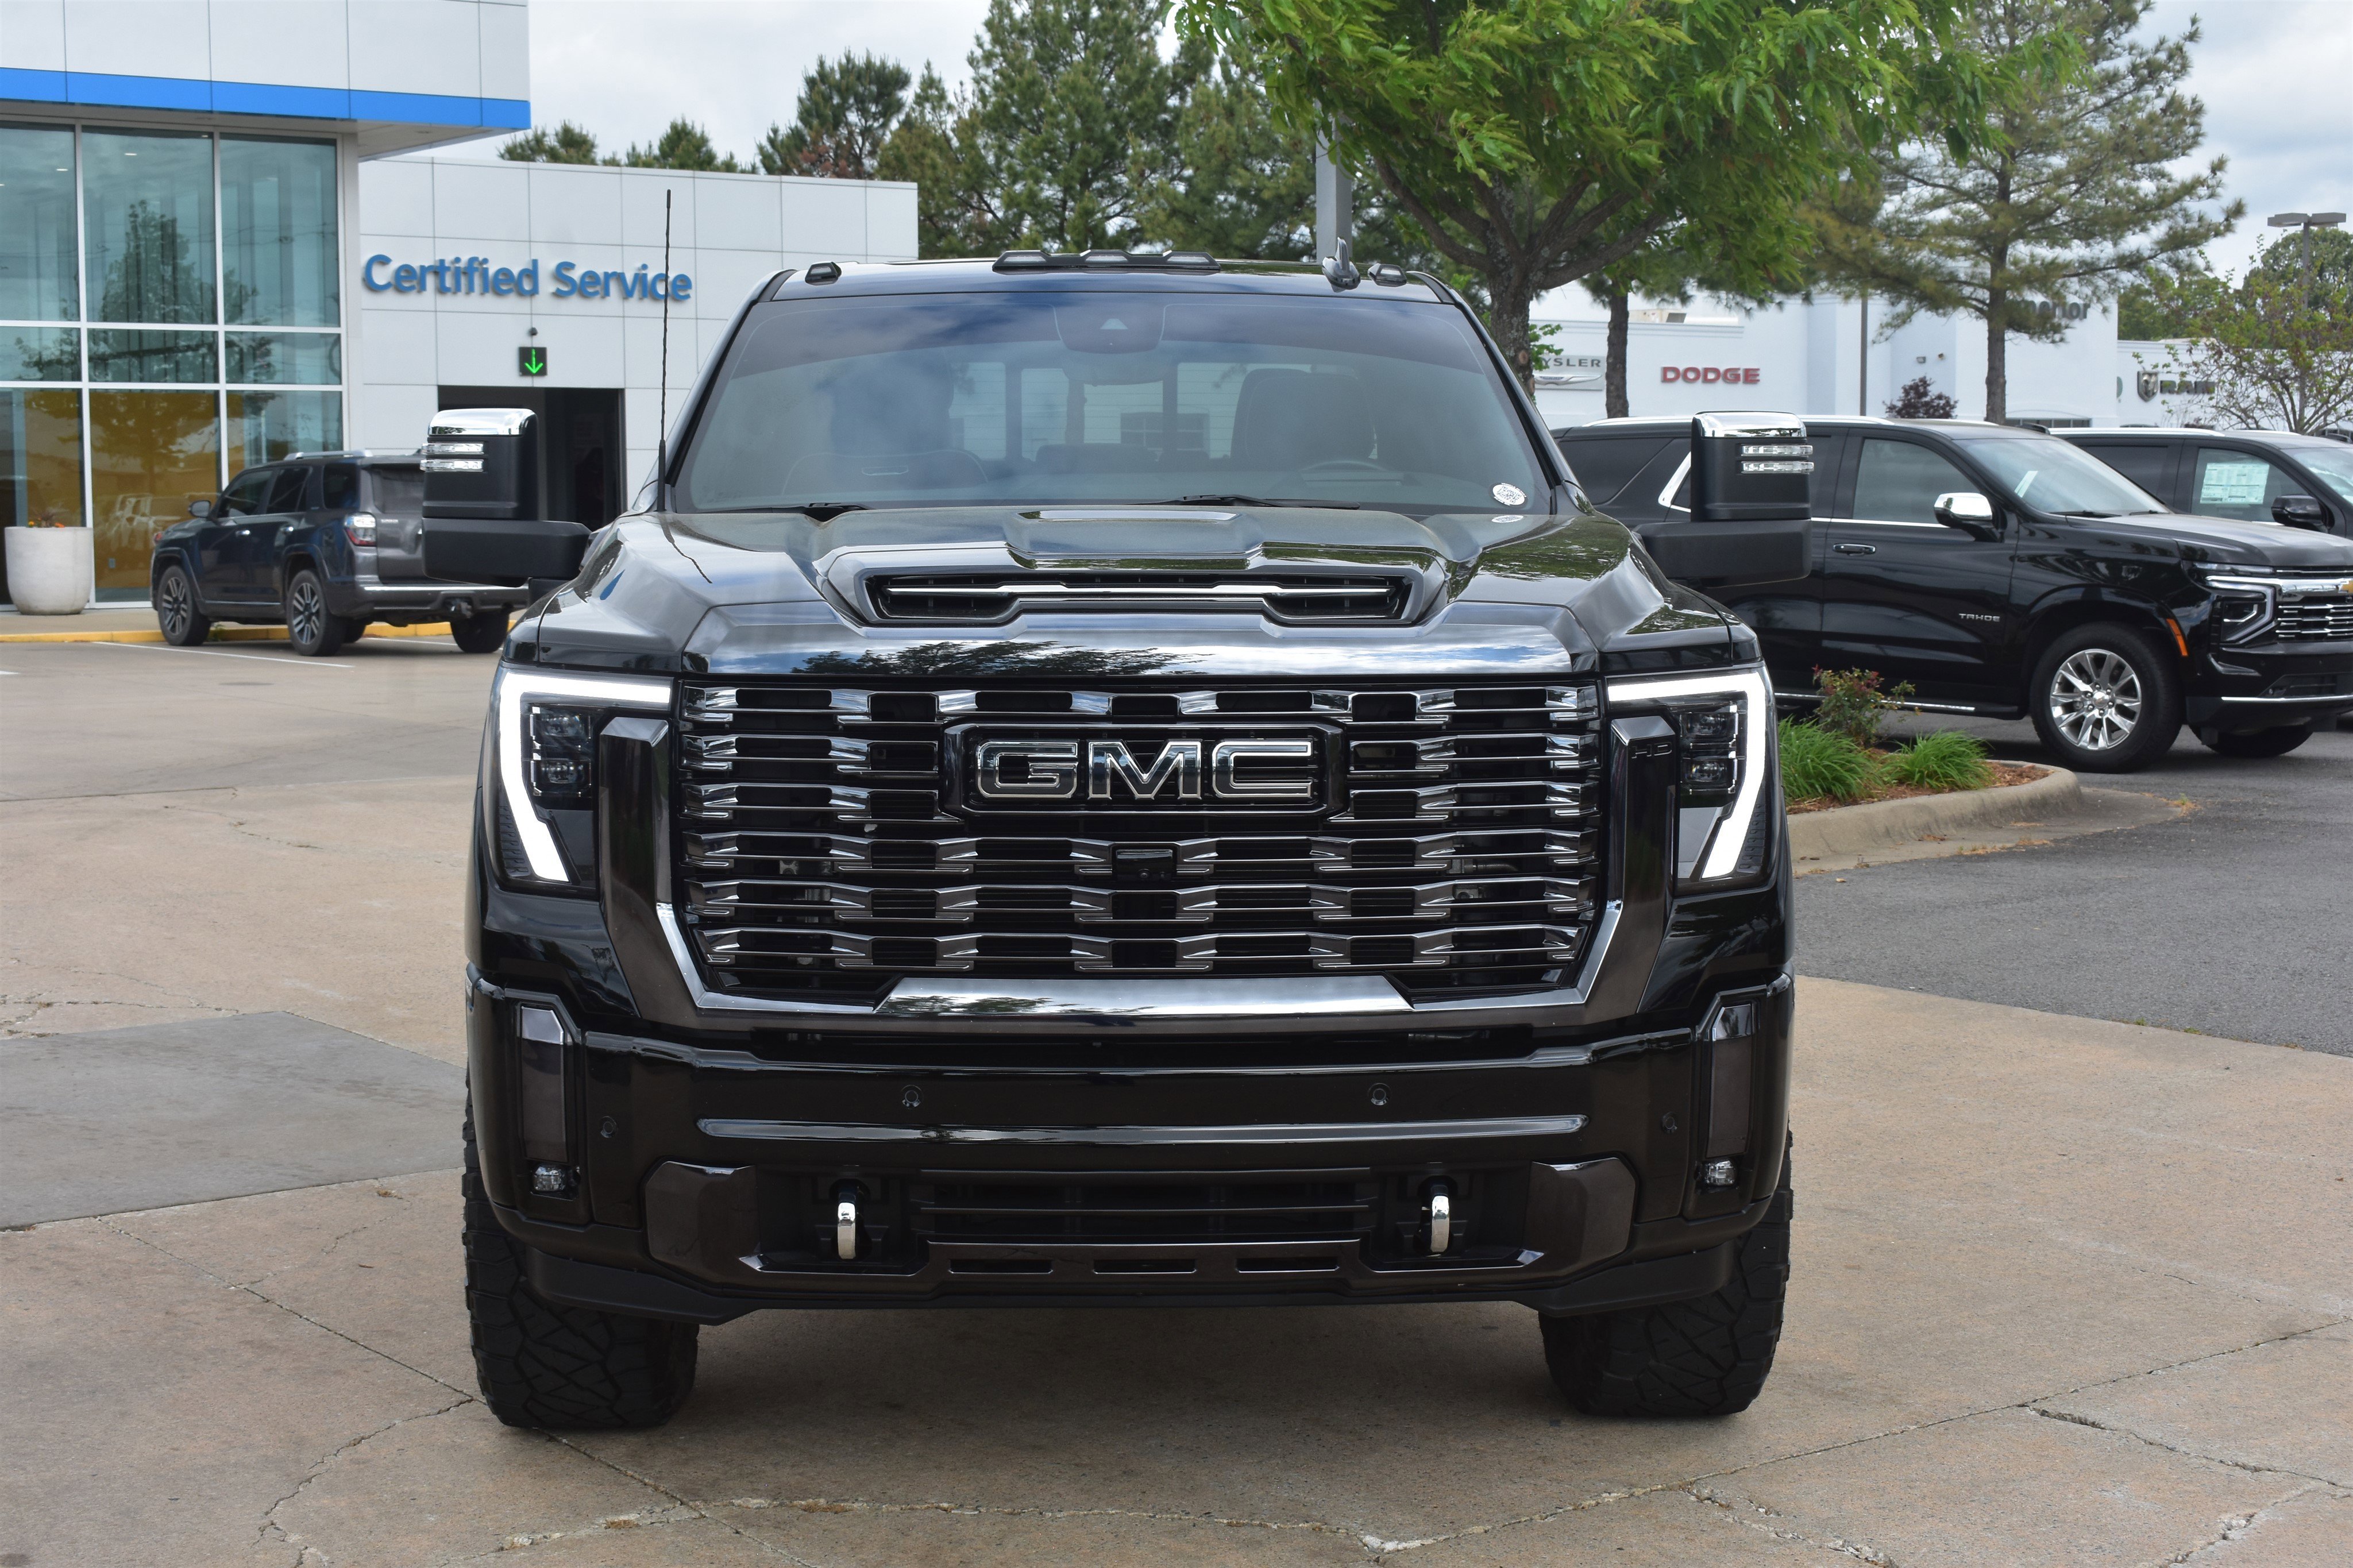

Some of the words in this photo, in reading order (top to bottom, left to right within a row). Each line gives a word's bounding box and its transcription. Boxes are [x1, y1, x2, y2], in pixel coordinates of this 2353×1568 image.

[365, 254, 540, 297] Certified
[554, 261, 693, 301] Service
[1541, 357, 1602, 368] YSLER
[1661, 366, 1761, 384] DODGE
[1958, 613, 2000, 622] TAHOE
[1631, 741, 1672, 759] HD
[977, 738, 1314, 799] GMC
